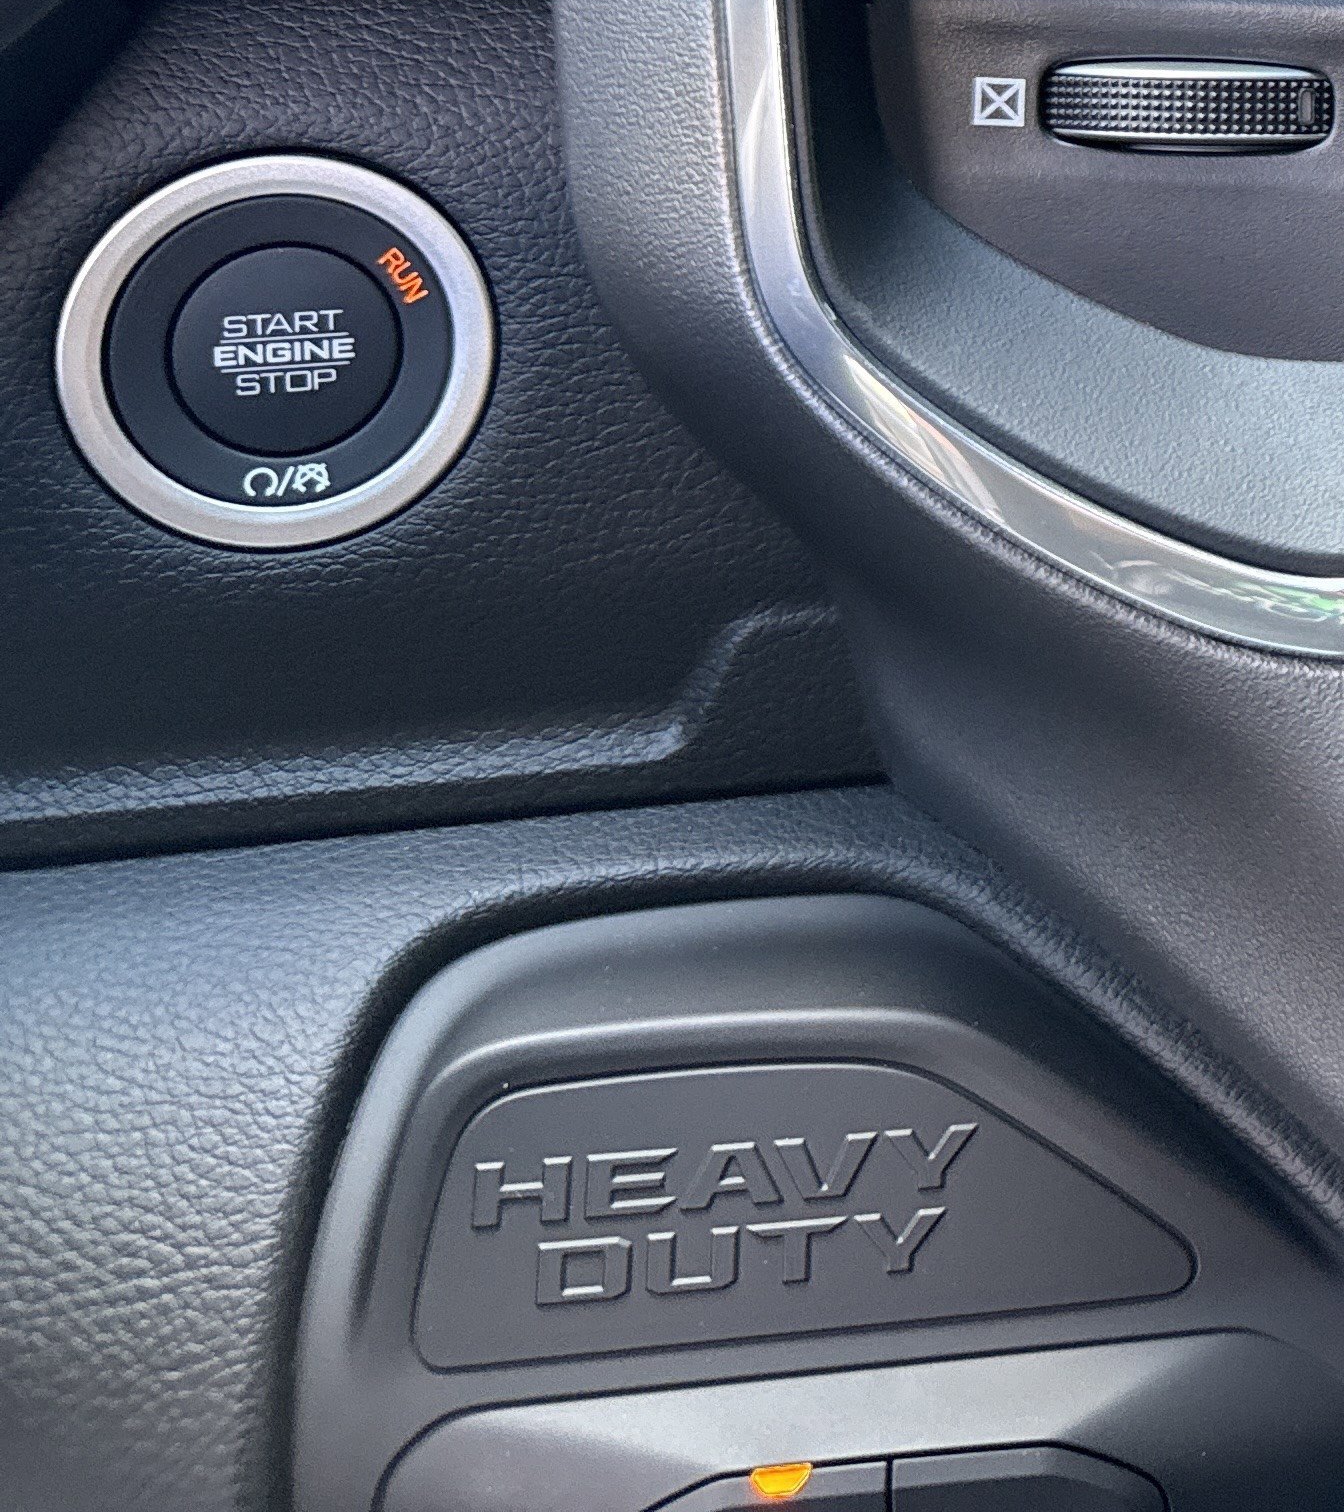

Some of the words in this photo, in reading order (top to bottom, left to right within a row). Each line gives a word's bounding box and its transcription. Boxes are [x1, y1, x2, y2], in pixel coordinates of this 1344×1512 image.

[376, 246, 430, 305] RUN
[221, 309, 344, 339] START
[213, 338, 356, 368] ENGINE
[234, 367, 338, 397] STOP
[470, 1122, 981, 1232] HEAVY
[533, 1206, 948, 1308] DUTY
